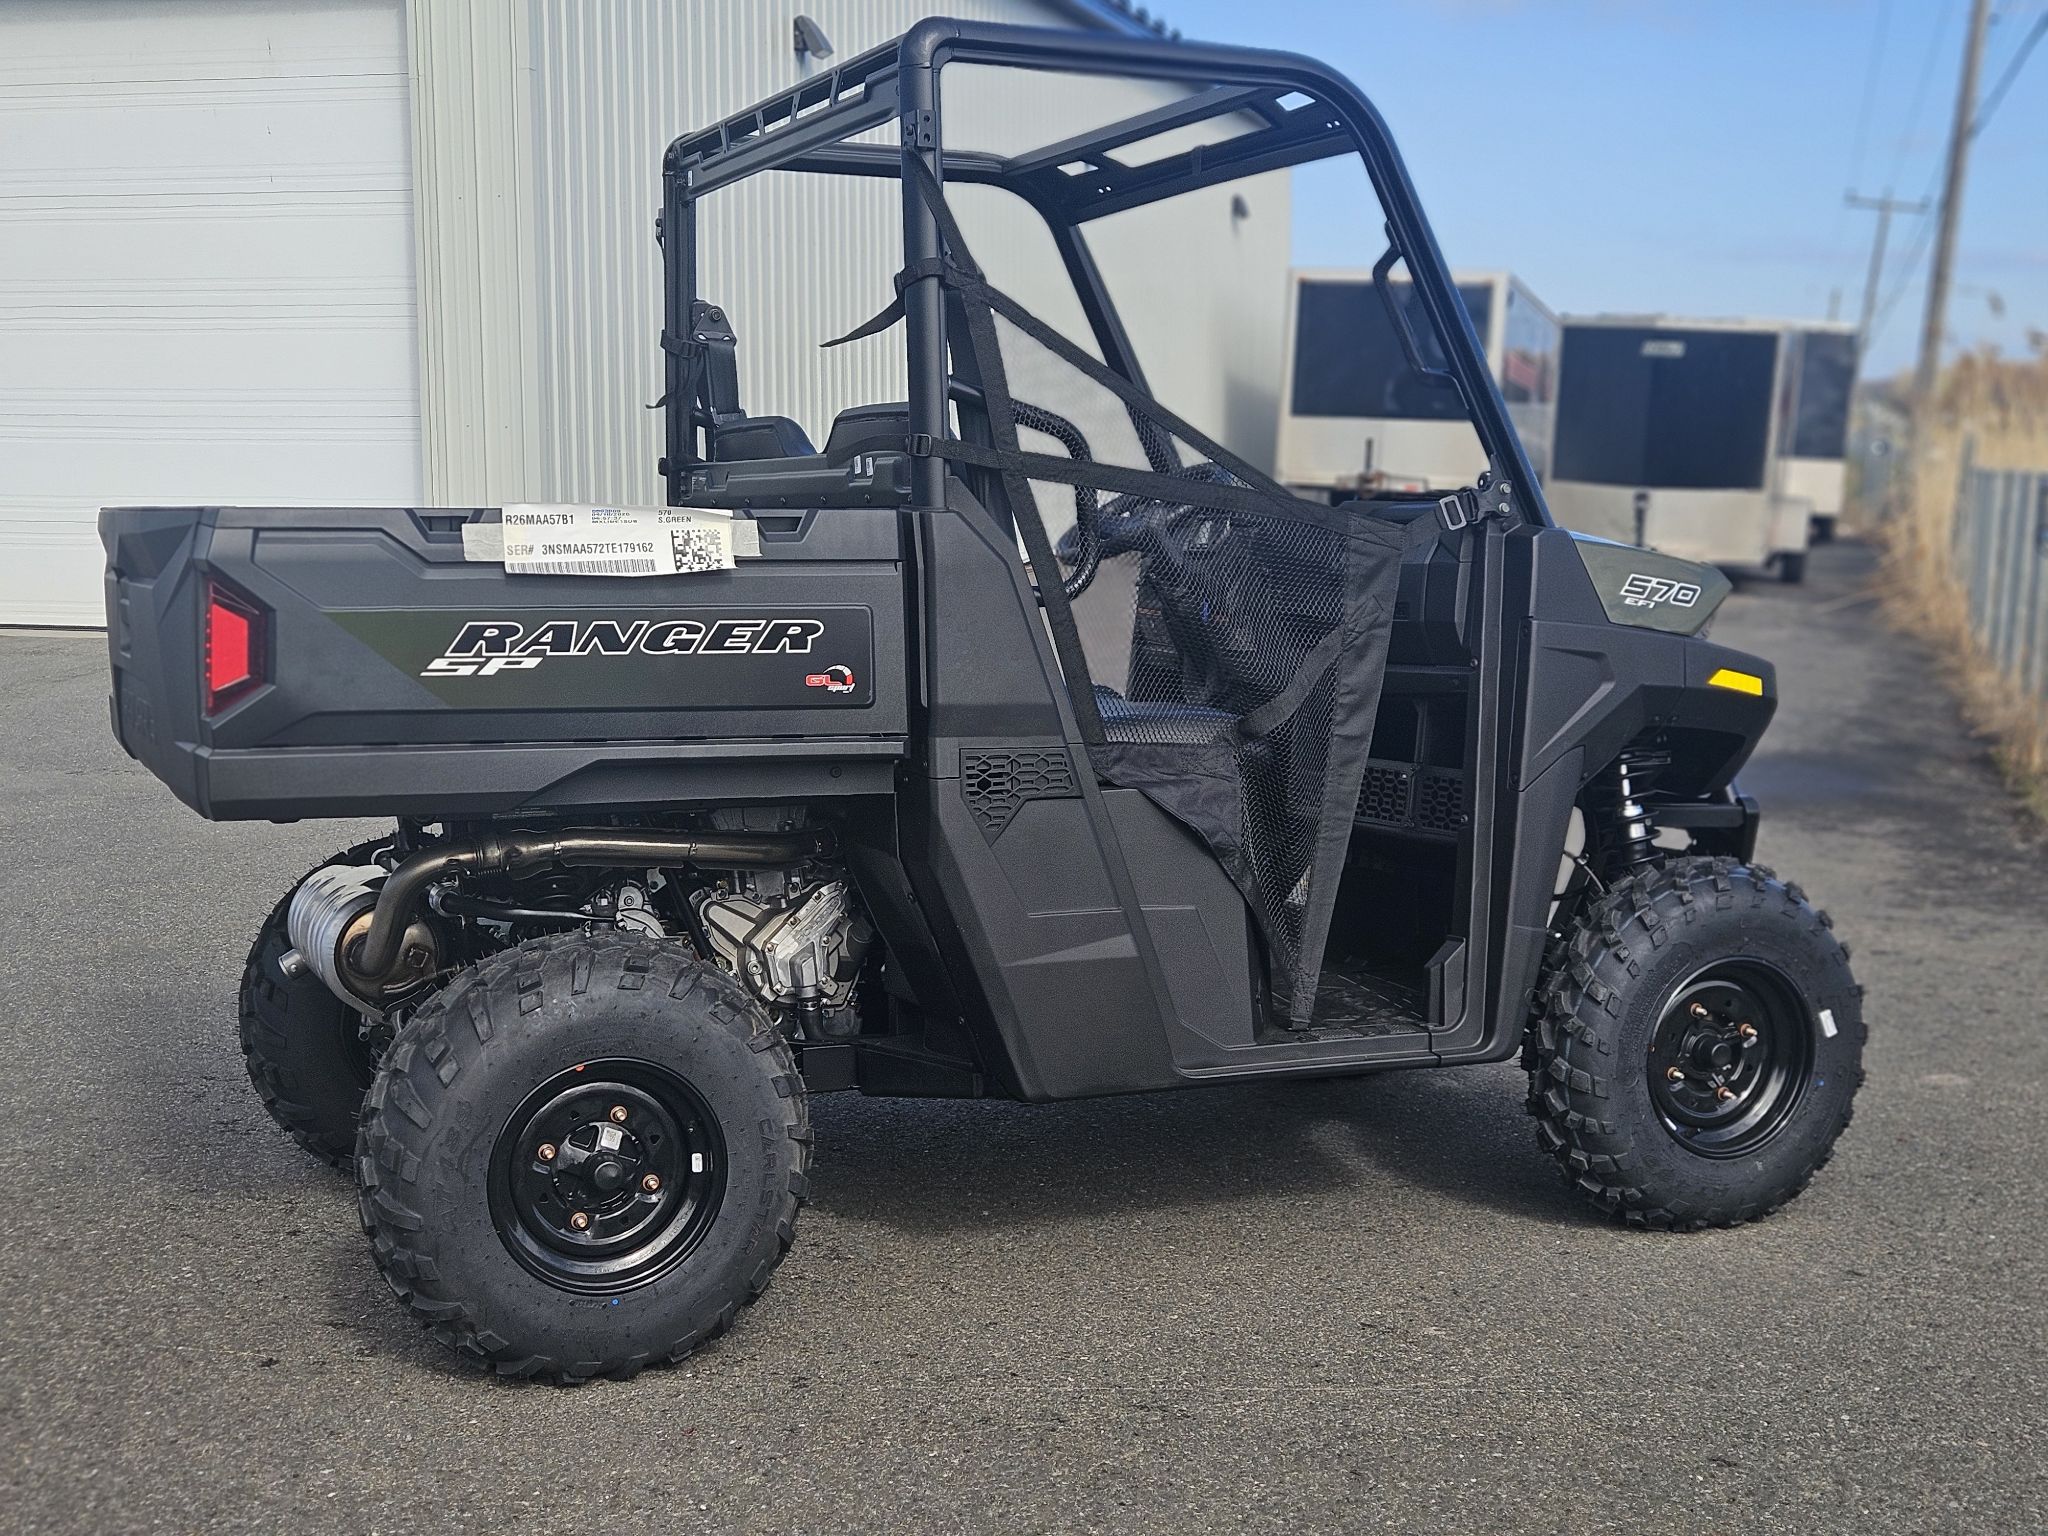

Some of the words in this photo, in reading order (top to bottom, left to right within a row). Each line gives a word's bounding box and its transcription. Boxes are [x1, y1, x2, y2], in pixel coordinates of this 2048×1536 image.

[505, 513, 575, 526] R26MAA57B1
[657, 516, 692, 524] S.GREEN
[506, 544, 535, 556] SER#
[541, 543, 655, 556] 3NSMAA572TE179162
[1619, 573, 1702, 608] 570
[1624, 597, 1656, 608] EFI
[444, 619, 826, 657] RANGER
[419, 657, 544, 677] SP
[805, 674, 843, 687] GL
